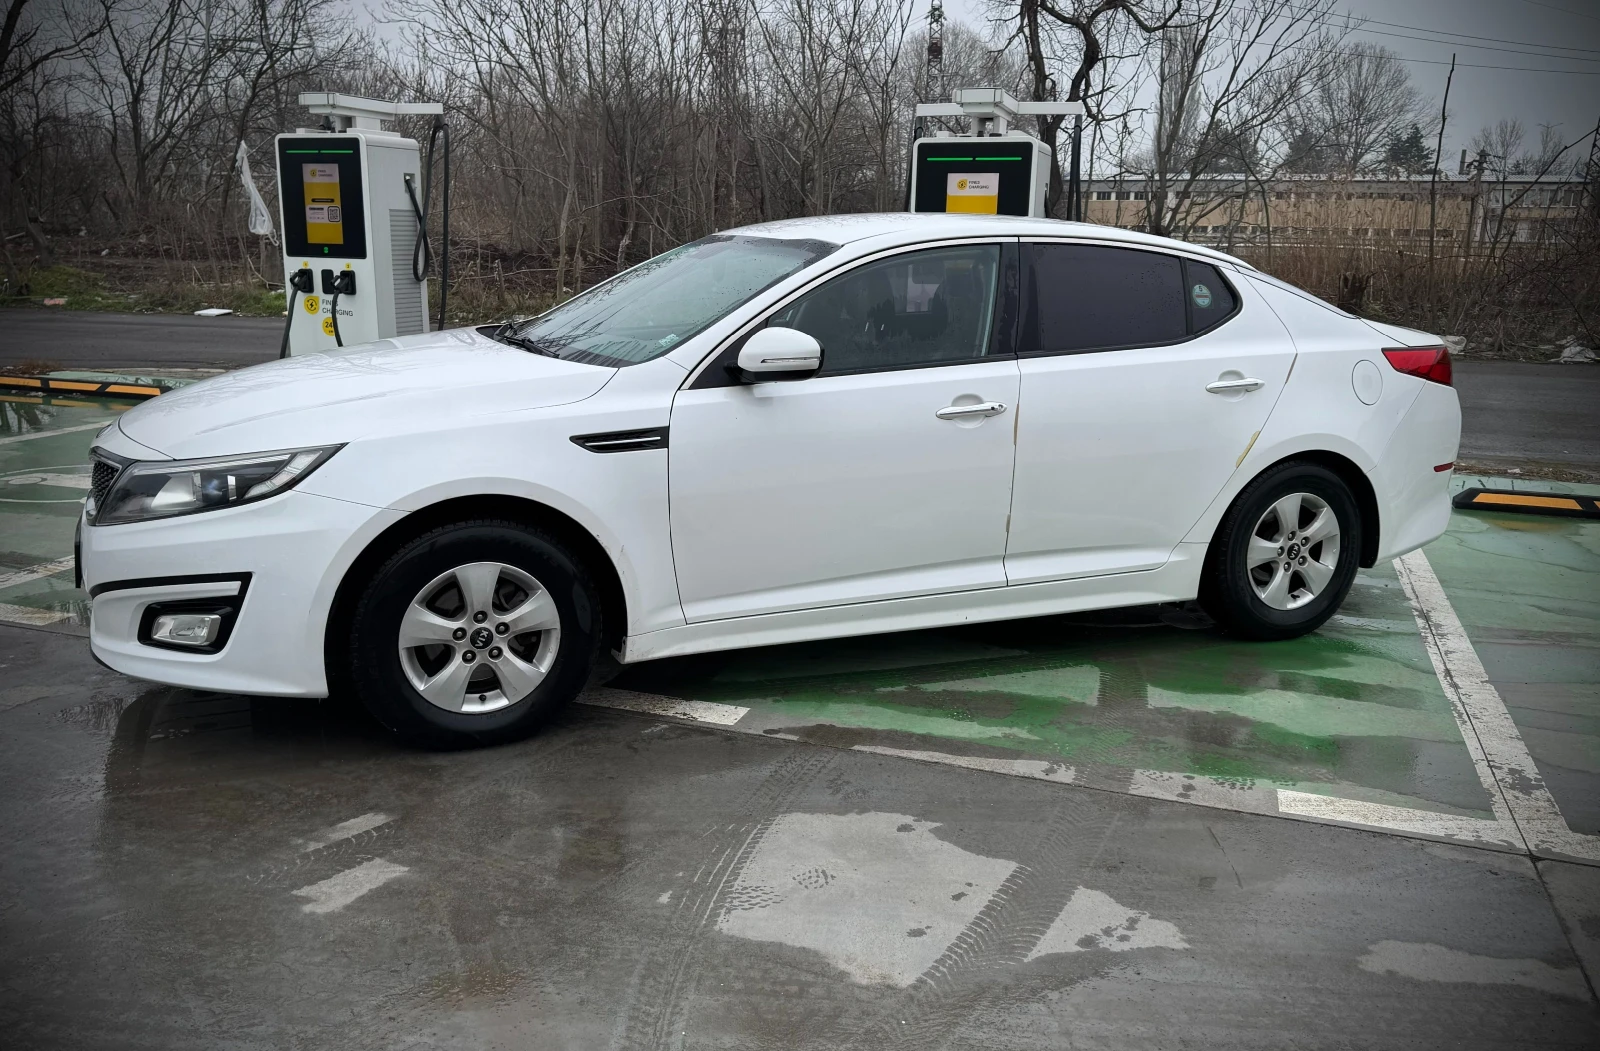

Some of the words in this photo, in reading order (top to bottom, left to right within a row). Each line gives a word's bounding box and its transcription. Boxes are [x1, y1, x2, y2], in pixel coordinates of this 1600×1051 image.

[322, 308, 353, 316] CHRGING
[1290, 545, 1299, 557] KIA
[475, 630, 488, 646] KIA
